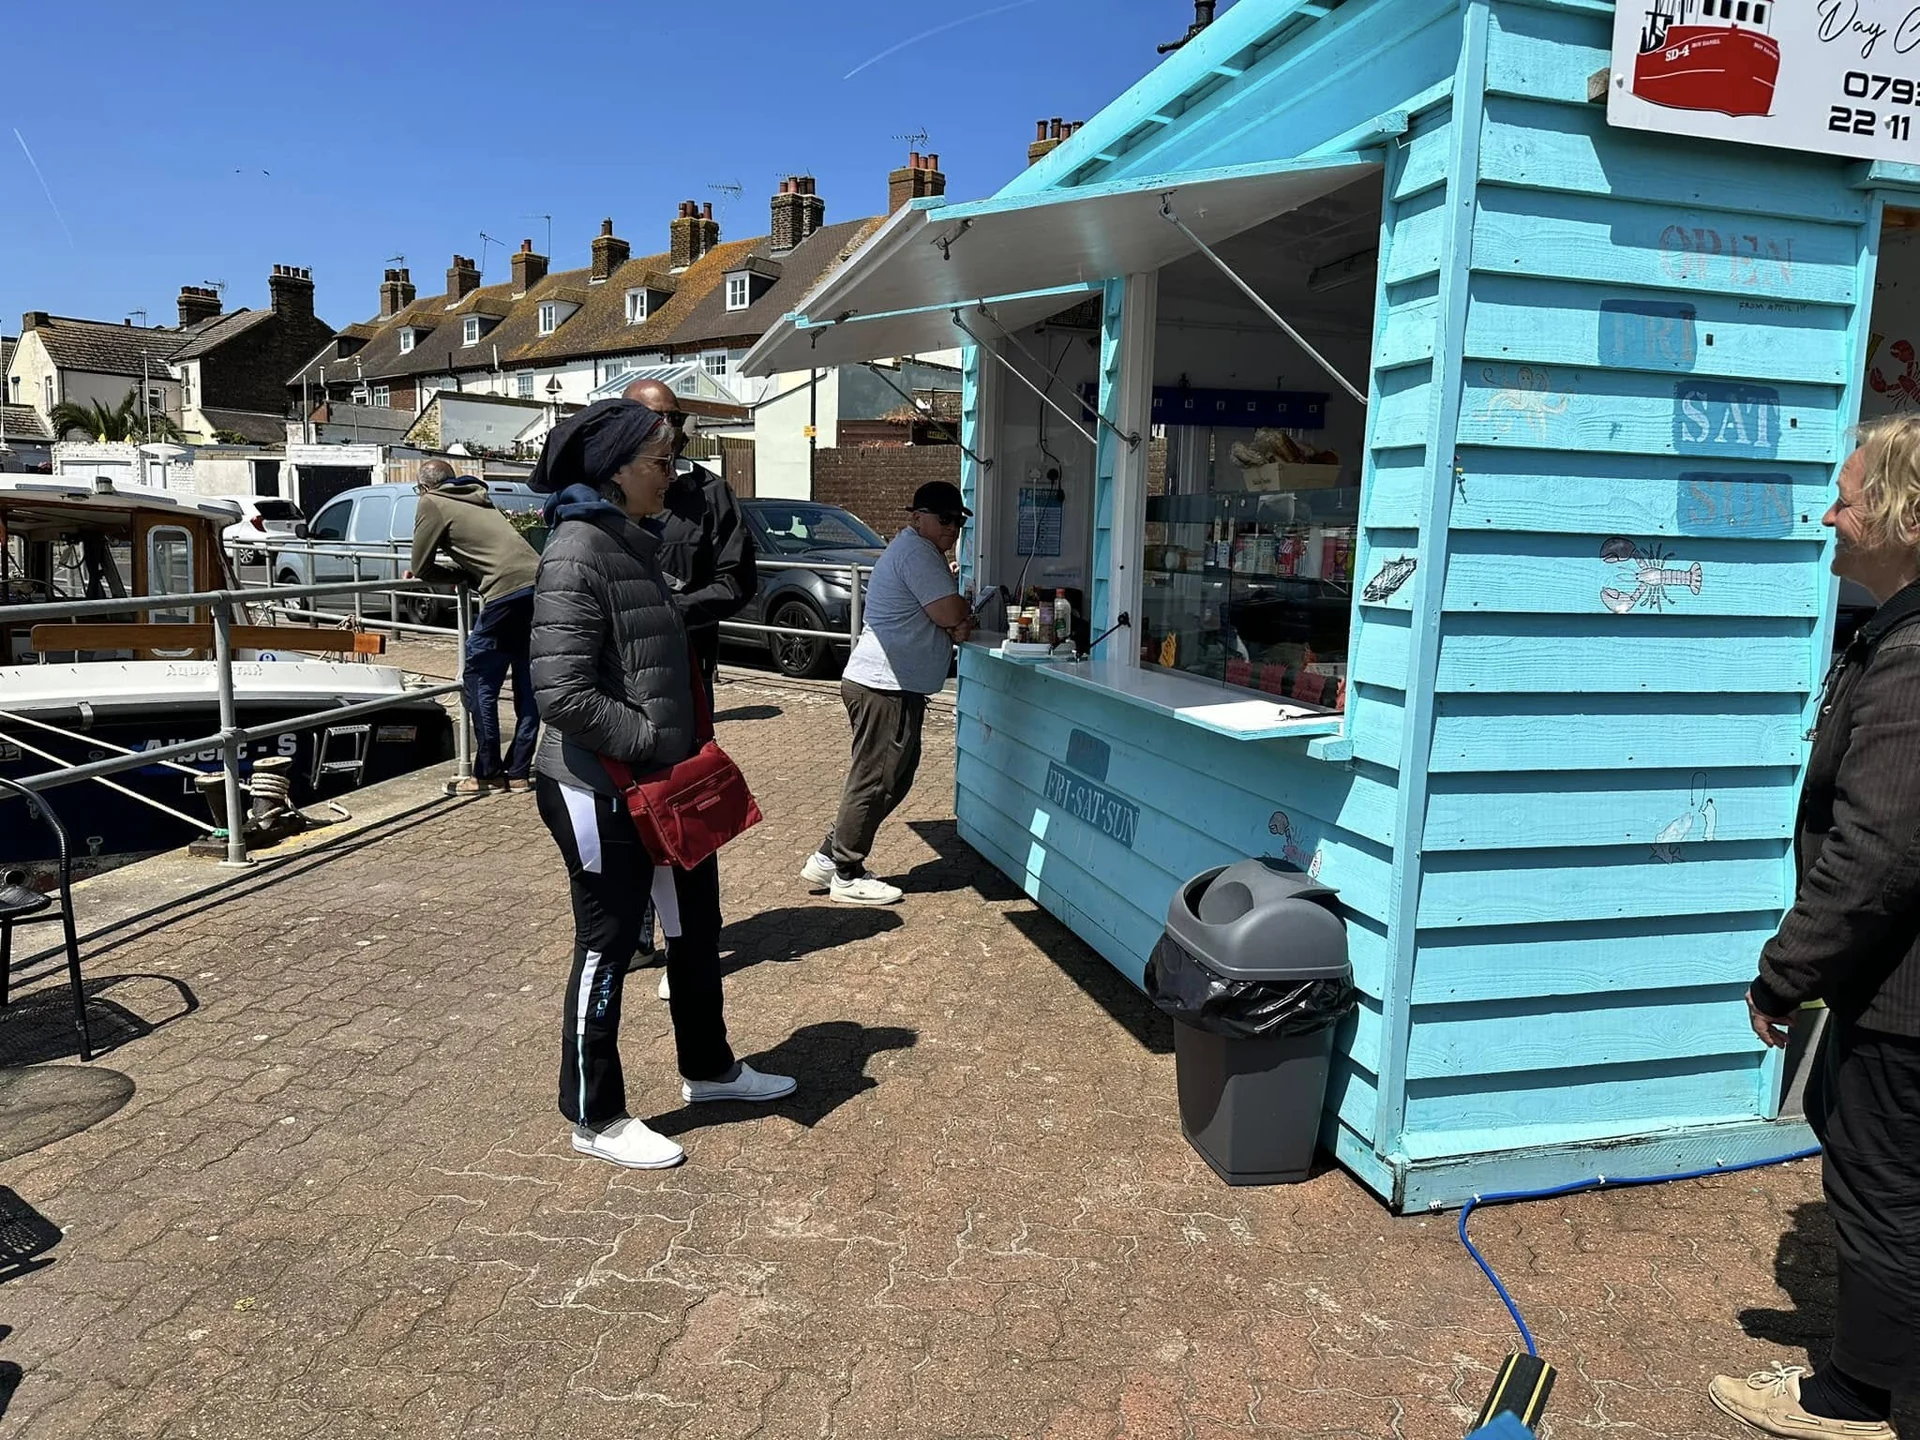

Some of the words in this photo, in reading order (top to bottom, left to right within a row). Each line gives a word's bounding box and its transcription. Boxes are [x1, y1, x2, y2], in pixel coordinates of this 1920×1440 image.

[1665, 44, 1690, 61] SD-4
[1817, 0, 1887, 59] Day
[1828, 105, 1876, 136] 22
[1890, 114, 1910, 141] 11
[1658, 224, 1794, 286] OPEN
[1613, 311, 1696, 362] FRI
[1681, 389, 1780, 448] SAT
[1687, 477, 1790, 526] SUN
[277, 733, 298, 757] S
